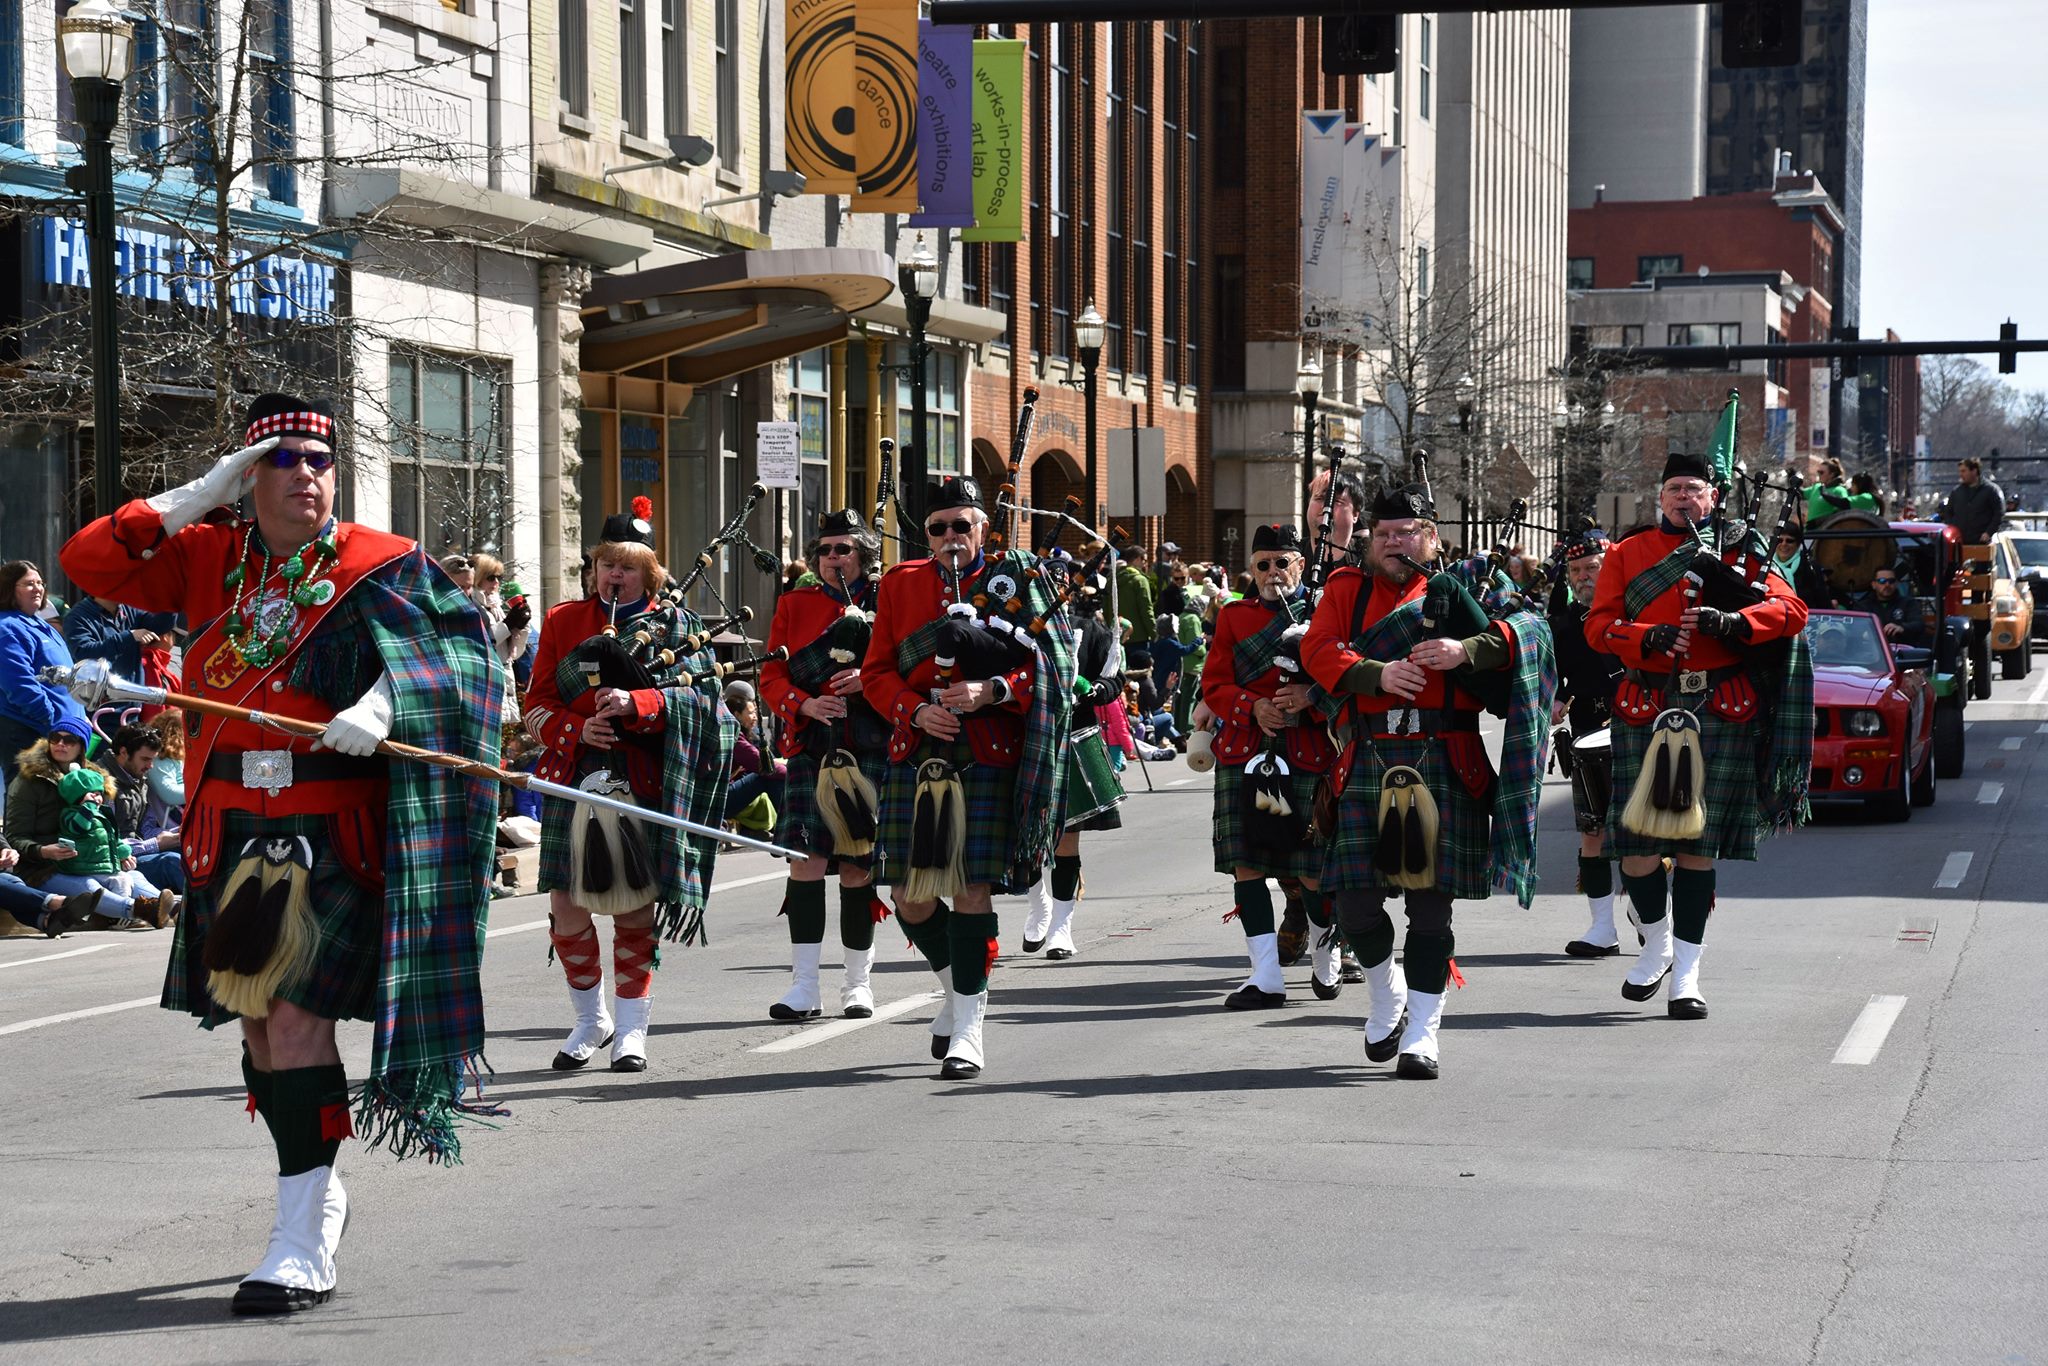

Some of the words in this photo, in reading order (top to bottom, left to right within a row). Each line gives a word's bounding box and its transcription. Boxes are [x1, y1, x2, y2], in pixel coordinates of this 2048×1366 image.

[791, 0, 829, 19] mu
[918, 38, 957, 90] heatre
[857, 78, 892, 129] dance
[923, 94, 952, 194] exhibitions
[972, 122, 987, 145] art
[976, 67, 1012, 217] works-in-process
[972, 152, 987, 178] lab
